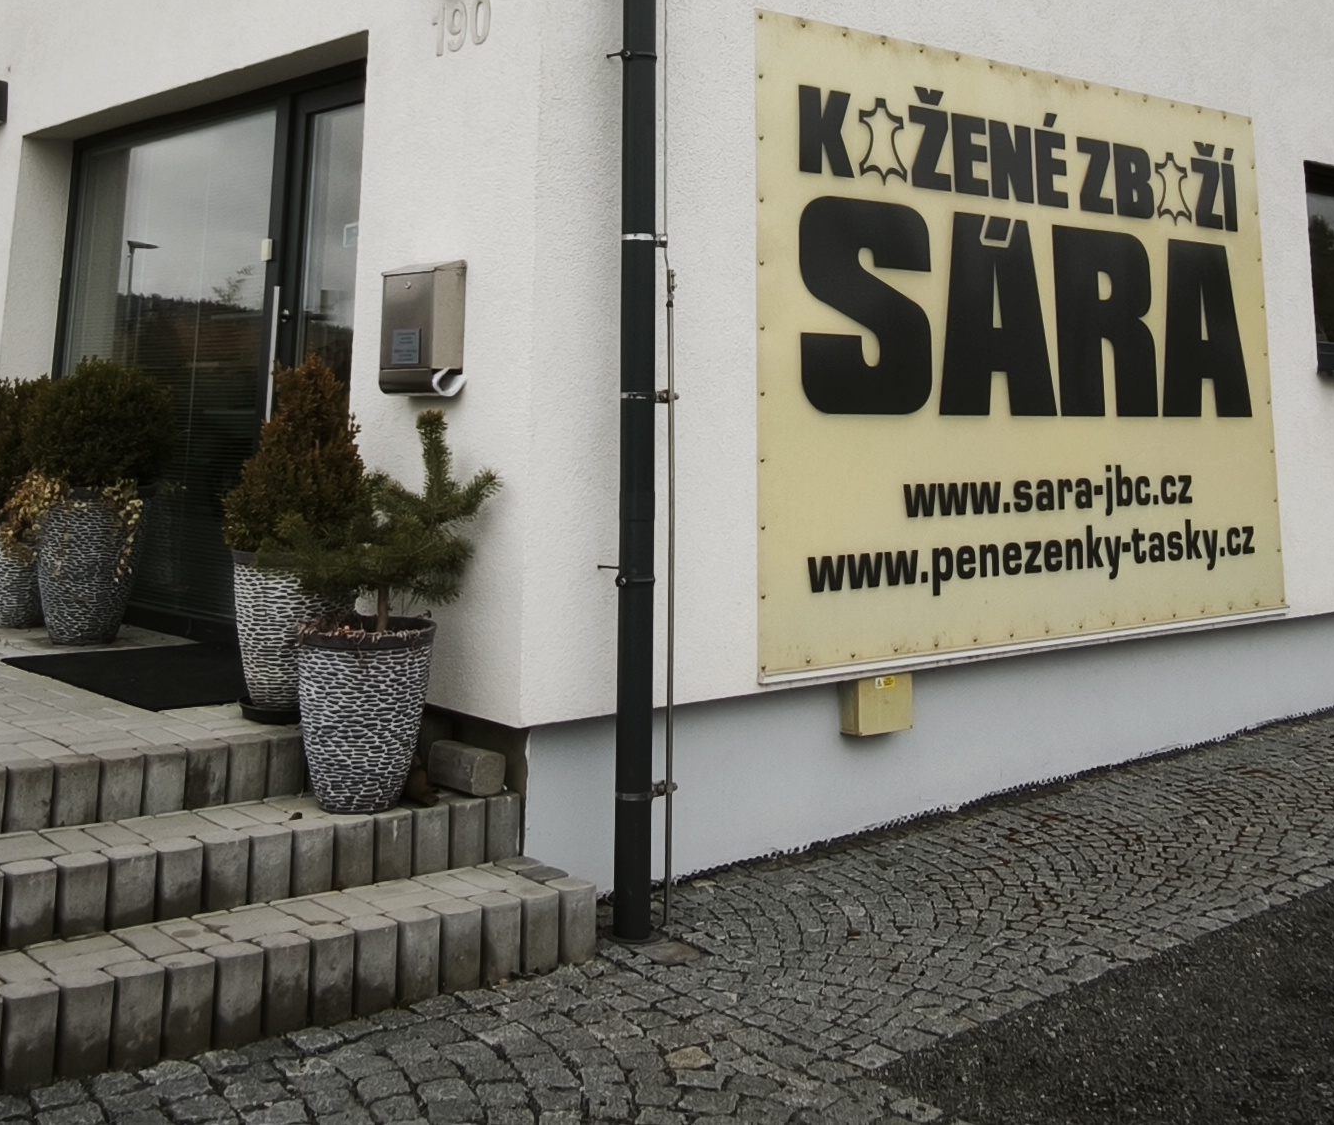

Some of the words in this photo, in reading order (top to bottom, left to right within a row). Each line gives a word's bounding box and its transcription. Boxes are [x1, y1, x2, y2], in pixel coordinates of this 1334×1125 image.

[798, 84, 1069, 209] KŽENÉ
[1076, 136, 1238, 232] ZBŽÍ
[798, 195, 1253, 418] SÁRA
[903, 464, 1193, 518] www.sara-jbc.cz
[807, 519, 1255, 596] www.penezenky-tasky.cz
